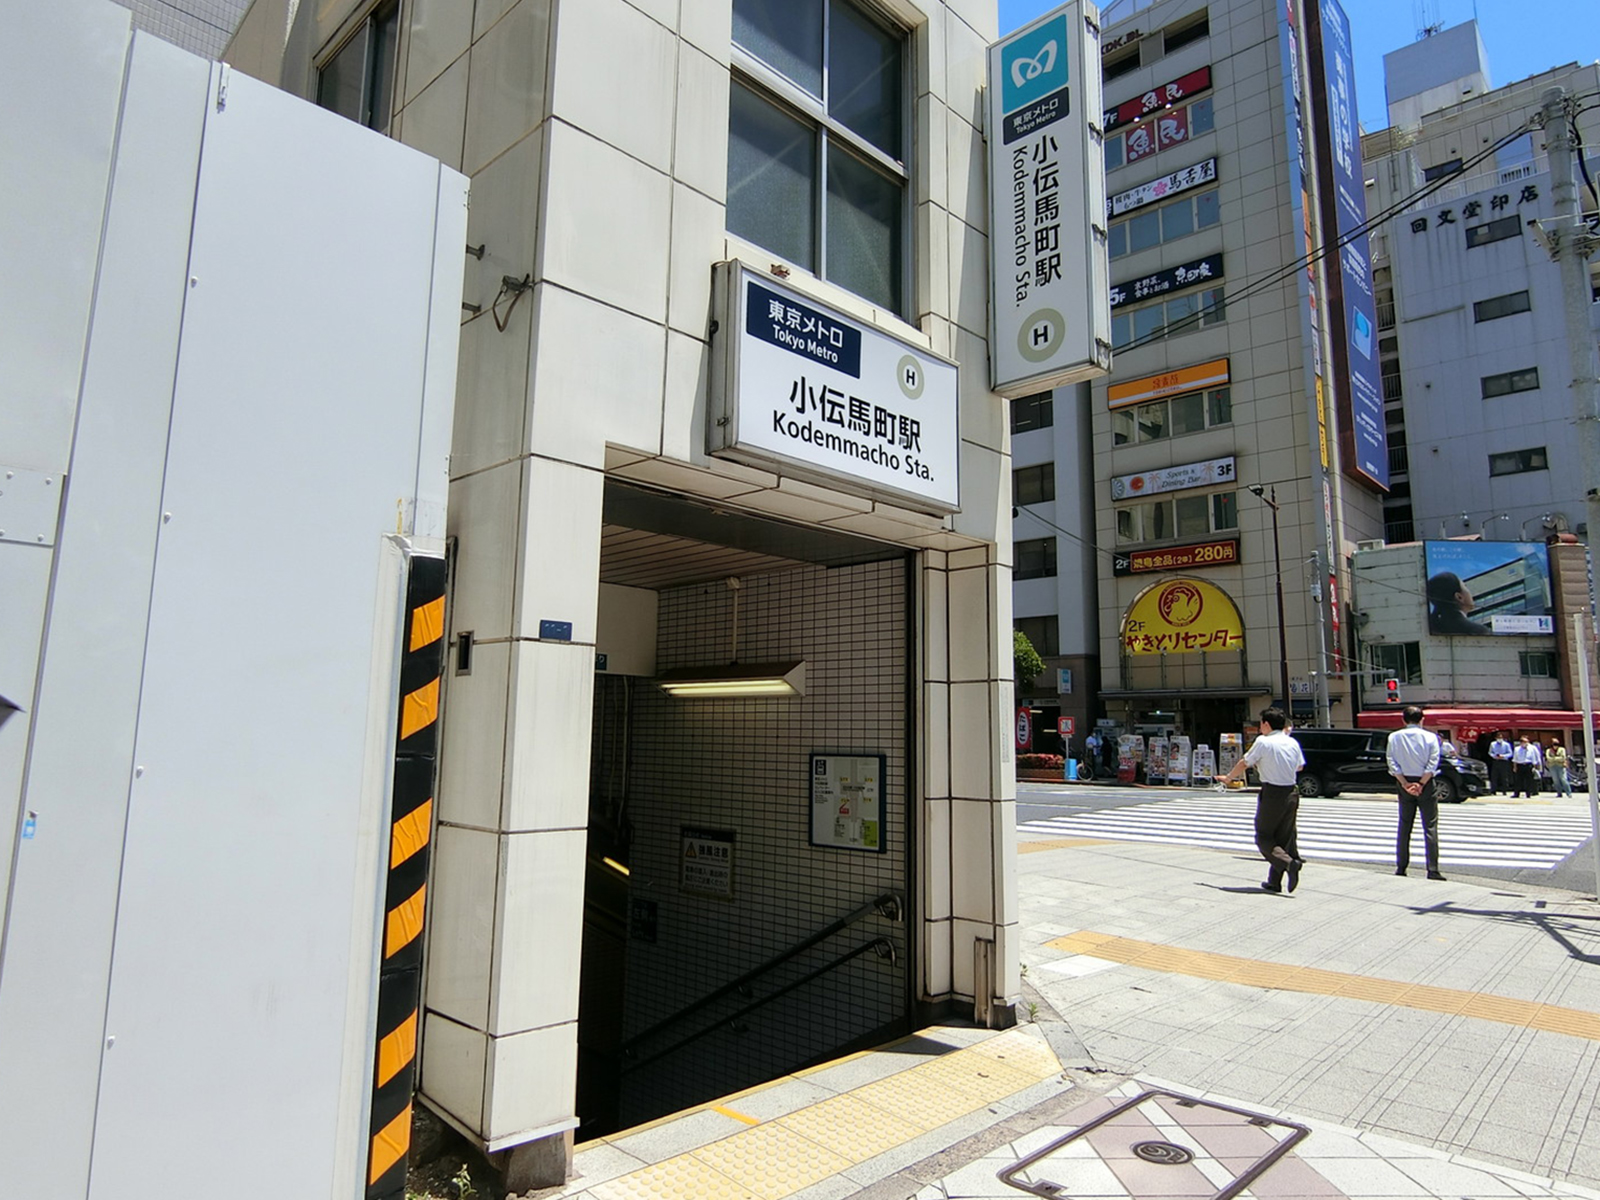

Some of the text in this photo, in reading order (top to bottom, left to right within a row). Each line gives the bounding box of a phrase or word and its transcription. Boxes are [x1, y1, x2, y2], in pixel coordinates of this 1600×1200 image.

[1013, 98, 1059, 128] 東京メトロ
[1016, 111, 1056, 133] Tokyo Metro
[1033, 135, 1062, 287] 小伝馬町駅
[1410, 185, 1539, 234] 回文堂印店
[1013, 145, 1031, 307] Kodemmacho Sta.
[768, 299, 843, 348] 東京メトロ
[1033, 325, 1049, 346] H
[772, 325, 838, 363] Tokyo Metro
[905, 369, 916, 386] H
[789, 376, 922, 453] 小伝馬町駅
[773, 410, 934, 482] Kodemmacho Sta.
[1217, 463, 1232, 476] 3F
[1115, 560, 1130, 570] 2F
[1126, 629, 1243, 652] やきとりセンター
[1128, 620, 1145, 632] 2F
